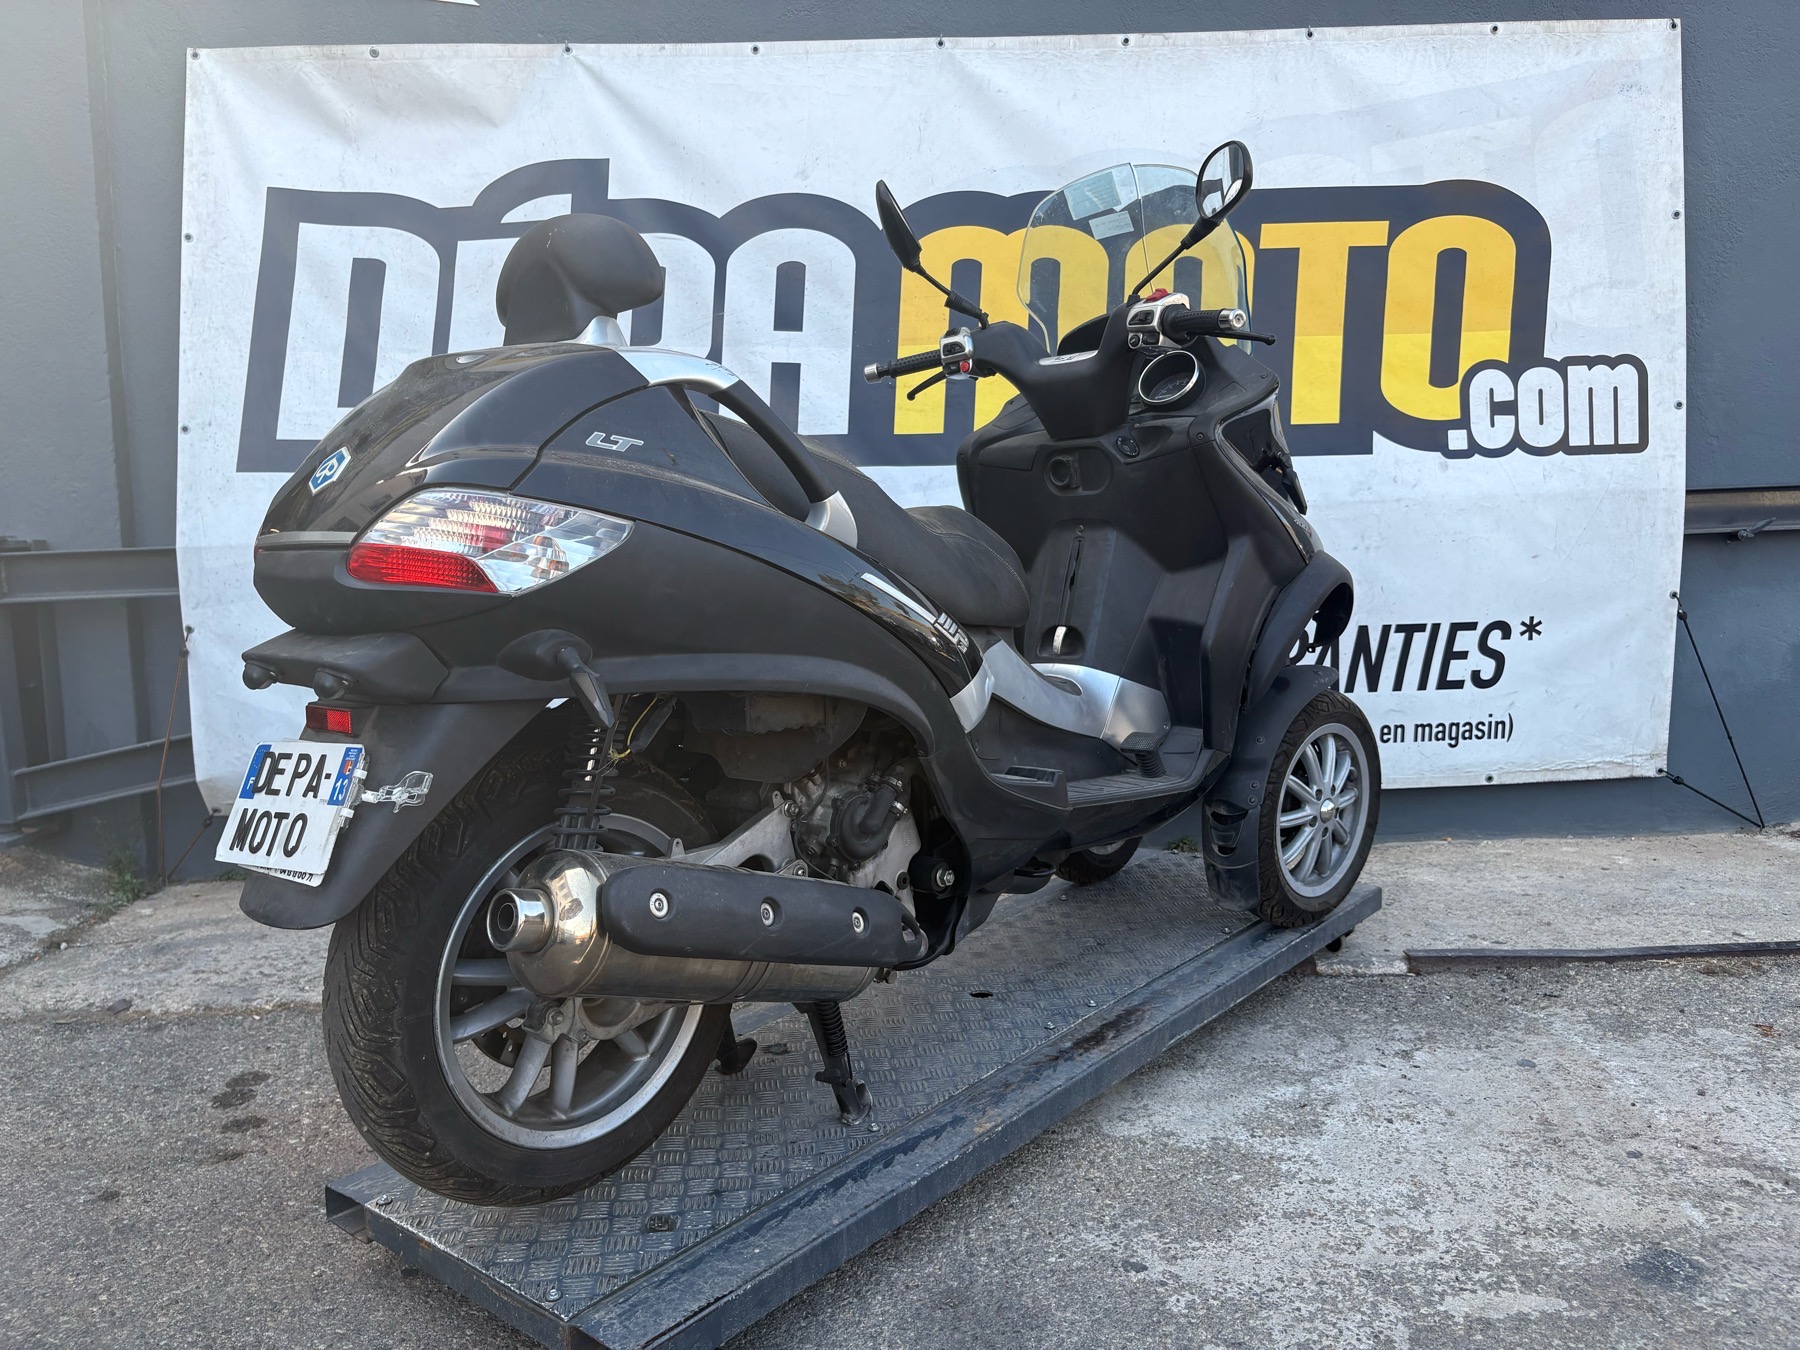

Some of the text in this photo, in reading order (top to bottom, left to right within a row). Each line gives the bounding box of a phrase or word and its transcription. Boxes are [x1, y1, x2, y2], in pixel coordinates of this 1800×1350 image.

[585, 431, 644, 452] LT
[1379, 713, 1514, 748] en magasin)
[333, 778, 349, 801] 13
[229, 807, 308, 857] MOTO
